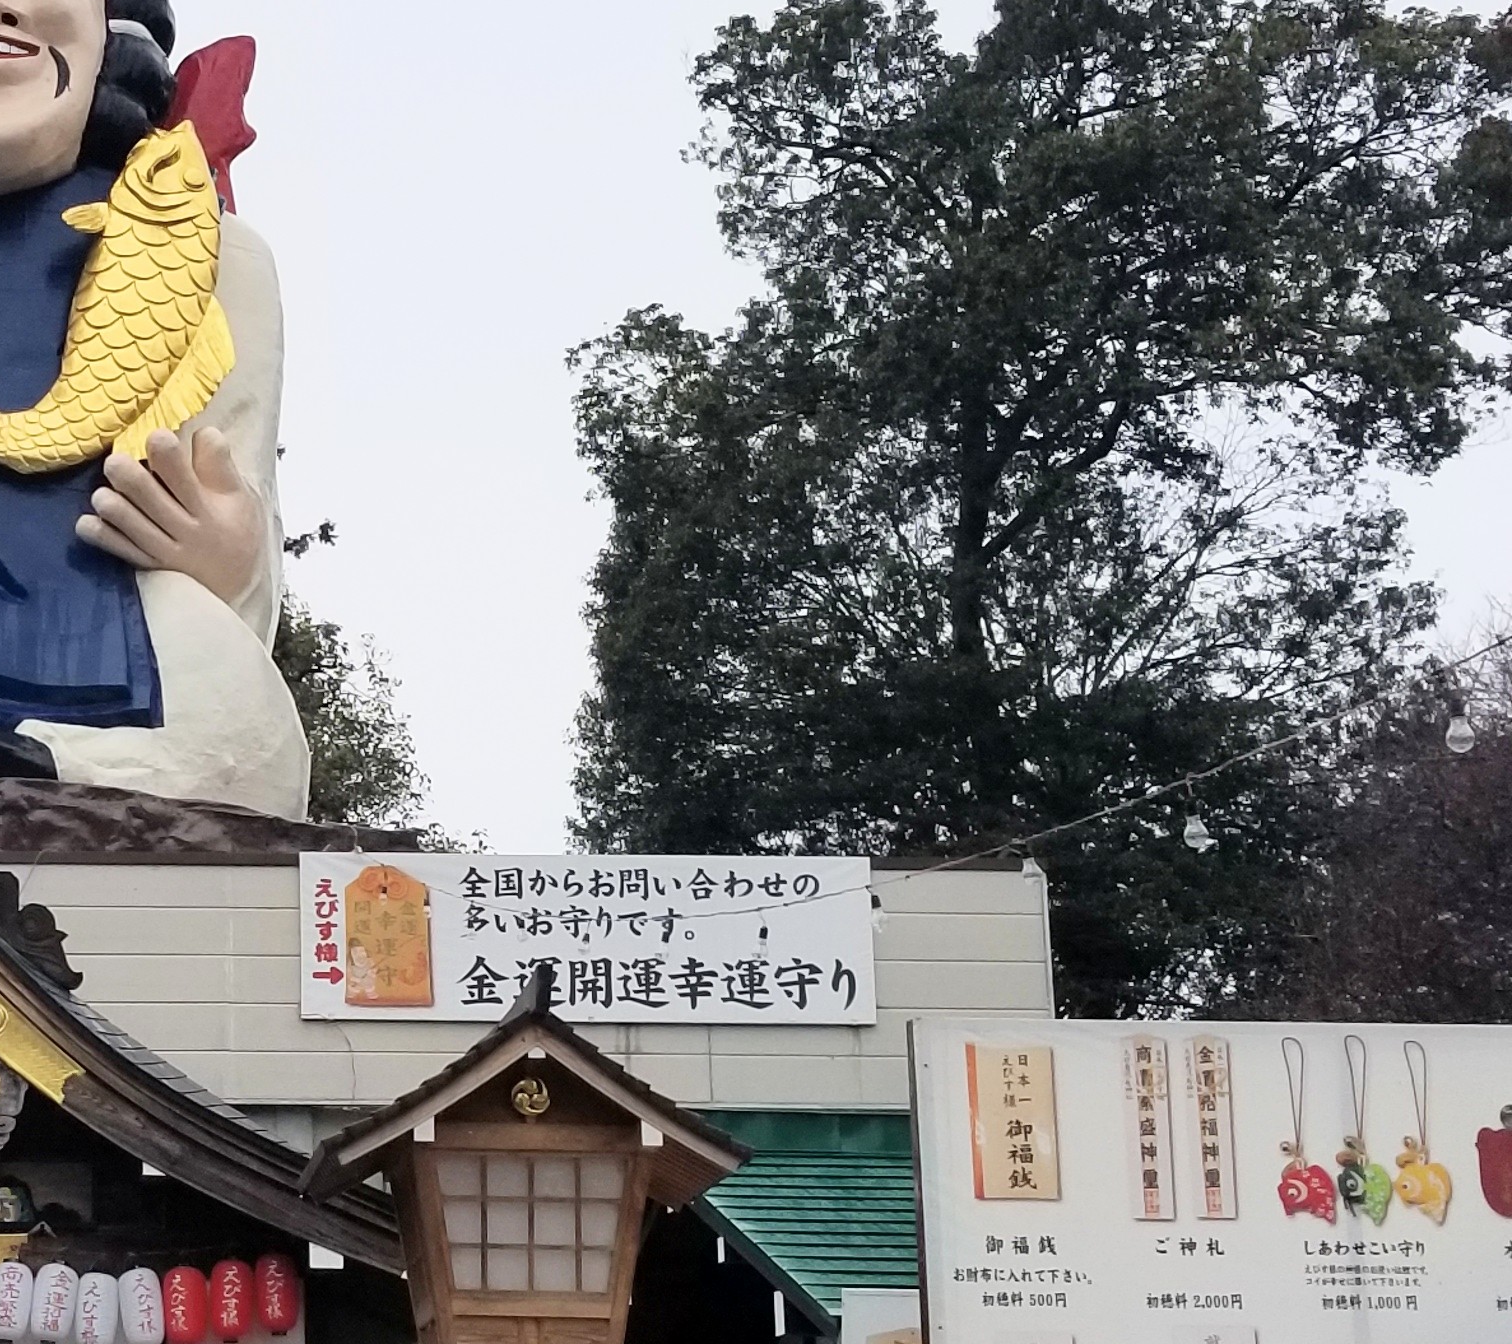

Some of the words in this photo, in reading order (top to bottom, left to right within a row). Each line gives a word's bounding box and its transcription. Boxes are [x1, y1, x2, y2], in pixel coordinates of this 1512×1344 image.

[459, 868, 820, 899] 全国からお問い合わせの
[315, 879, 339, 962] えびす様
[464, 902, 694, 943] 多いお守りです。
[1017, 1054, 1032, 1104] 日本一
[1005, 1119, 1037, 1189] 御福銭
[986, 1235, 1058, 1255] 御福銭
[1155, 1237, 1225, 1256] ご神札
[1304, 1240, 1425, 1257] しあわせこい守り
[266, 1260, 284, 1320] えびす様
[953, 1268, 1092, 1285] お財布に入れて下さい。
[221, 1266, 241, 1327] えびす様
[1029, 1292, 1068, 1307] 500円
[1368, 1296, 1401, 1311] 1,000
